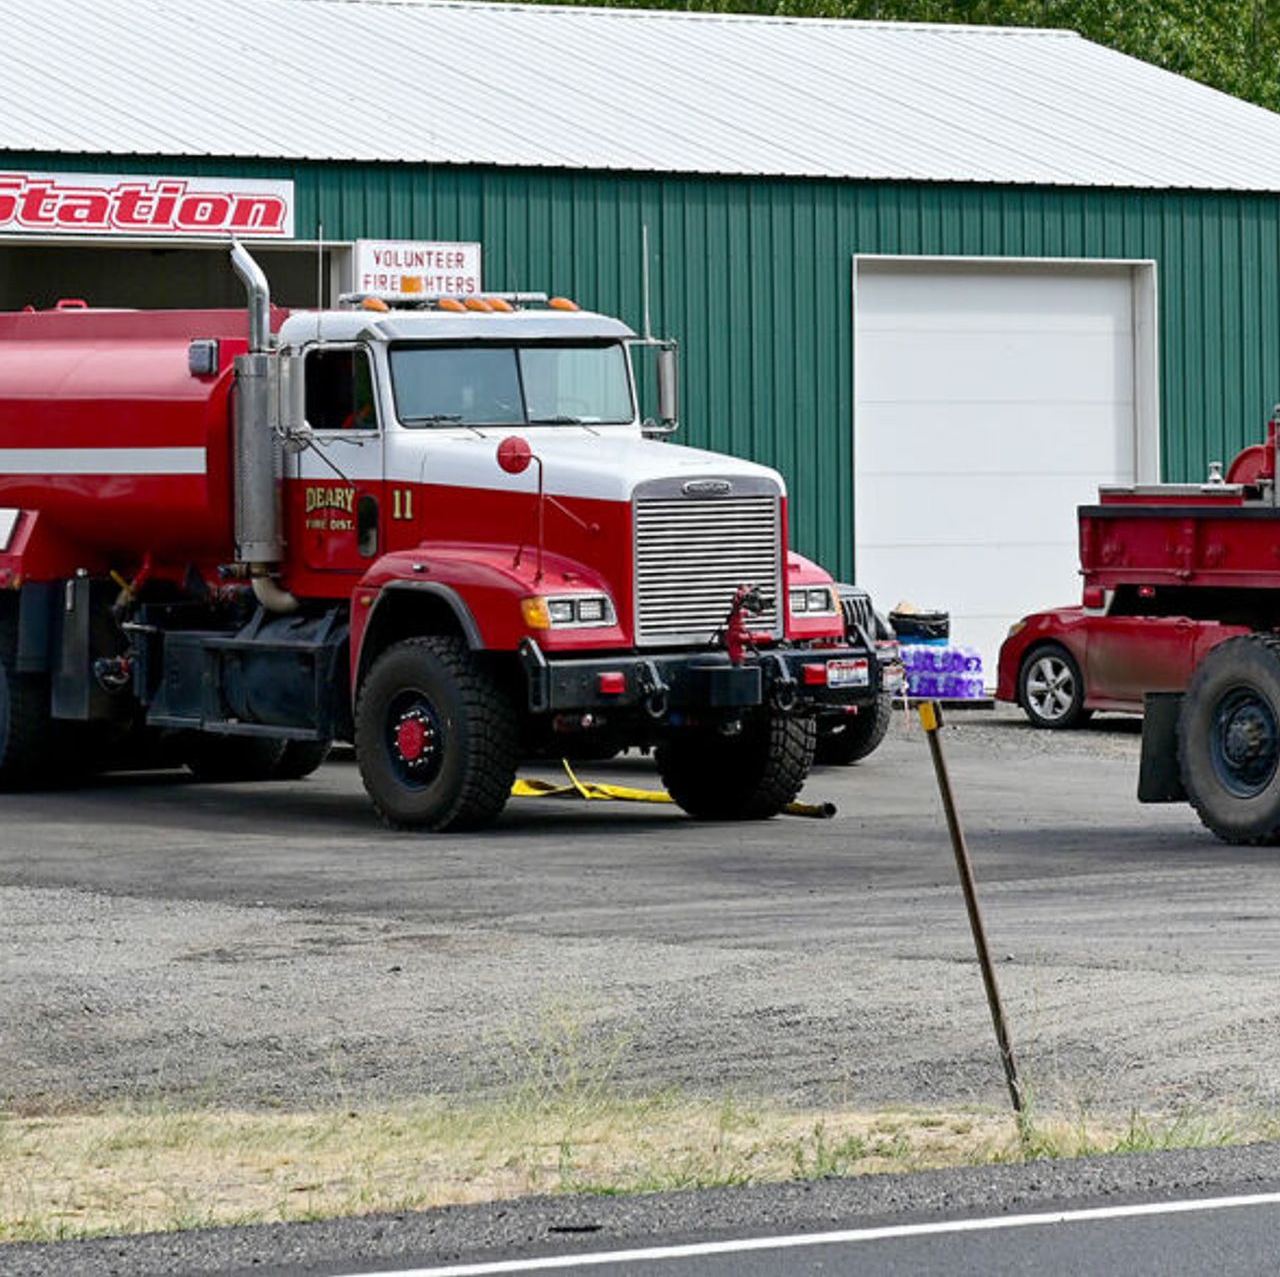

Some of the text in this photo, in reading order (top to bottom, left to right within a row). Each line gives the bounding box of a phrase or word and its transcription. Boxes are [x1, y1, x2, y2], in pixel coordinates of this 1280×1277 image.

[373, 249, 466, 269] VOLUNTEER
[363, 273, 476, 294] FIREHTERS
[305, 487, 355, 513] DEARY
[393, 489, 413, 519] 11
